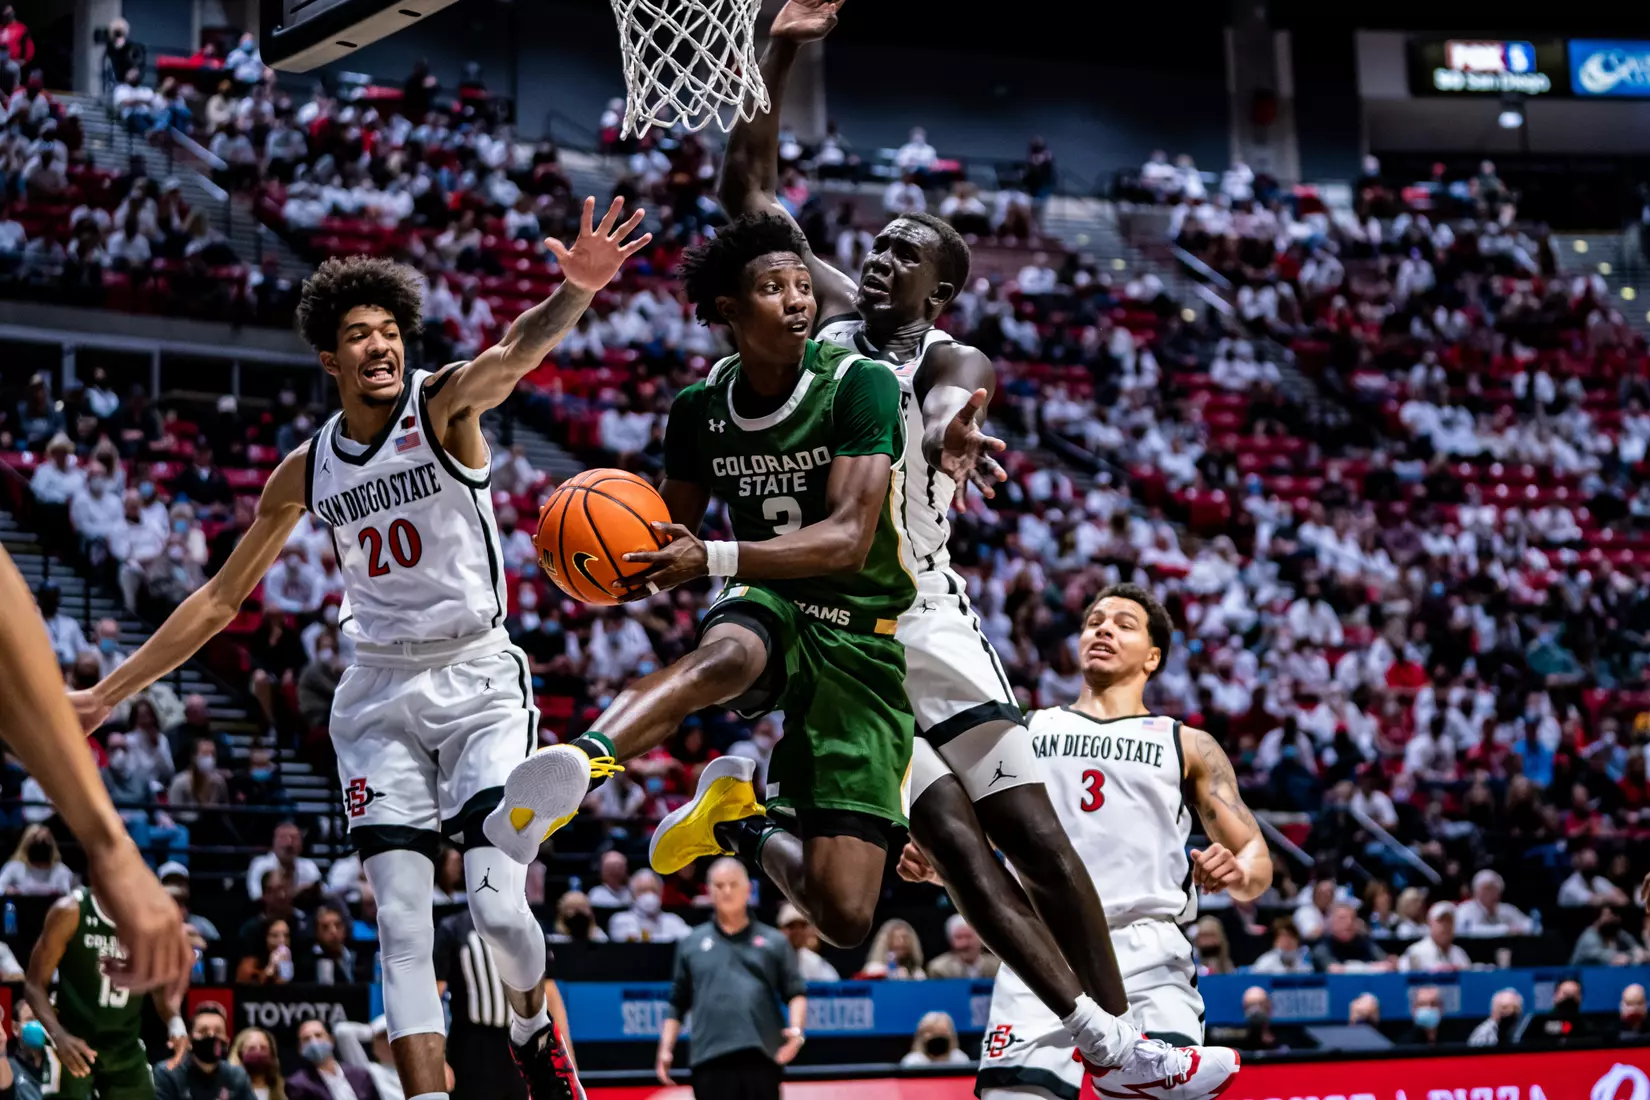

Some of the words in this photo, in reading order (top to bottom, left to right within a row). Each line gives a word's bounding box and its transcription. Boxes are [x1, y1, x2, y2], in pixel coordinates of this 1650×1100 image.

[712, 446, 832, 477] COLORADO
[318, 494, 349, 528] SAN
[344, 478, 390, 522] DIEGO
[389, 462, 442, 507] STATE
[738, 471, 807, 497] STATE
[358, 518, 422, 577] 20
[1032, 734, 1060, 758] SAN
[1062, 734, 1111, 759] DIEGO
[1114, 737, 1163, 768] STATE
[1081, 769, 1105, 812] 3
[243, 1002, 348, 1027] TOYOTA
